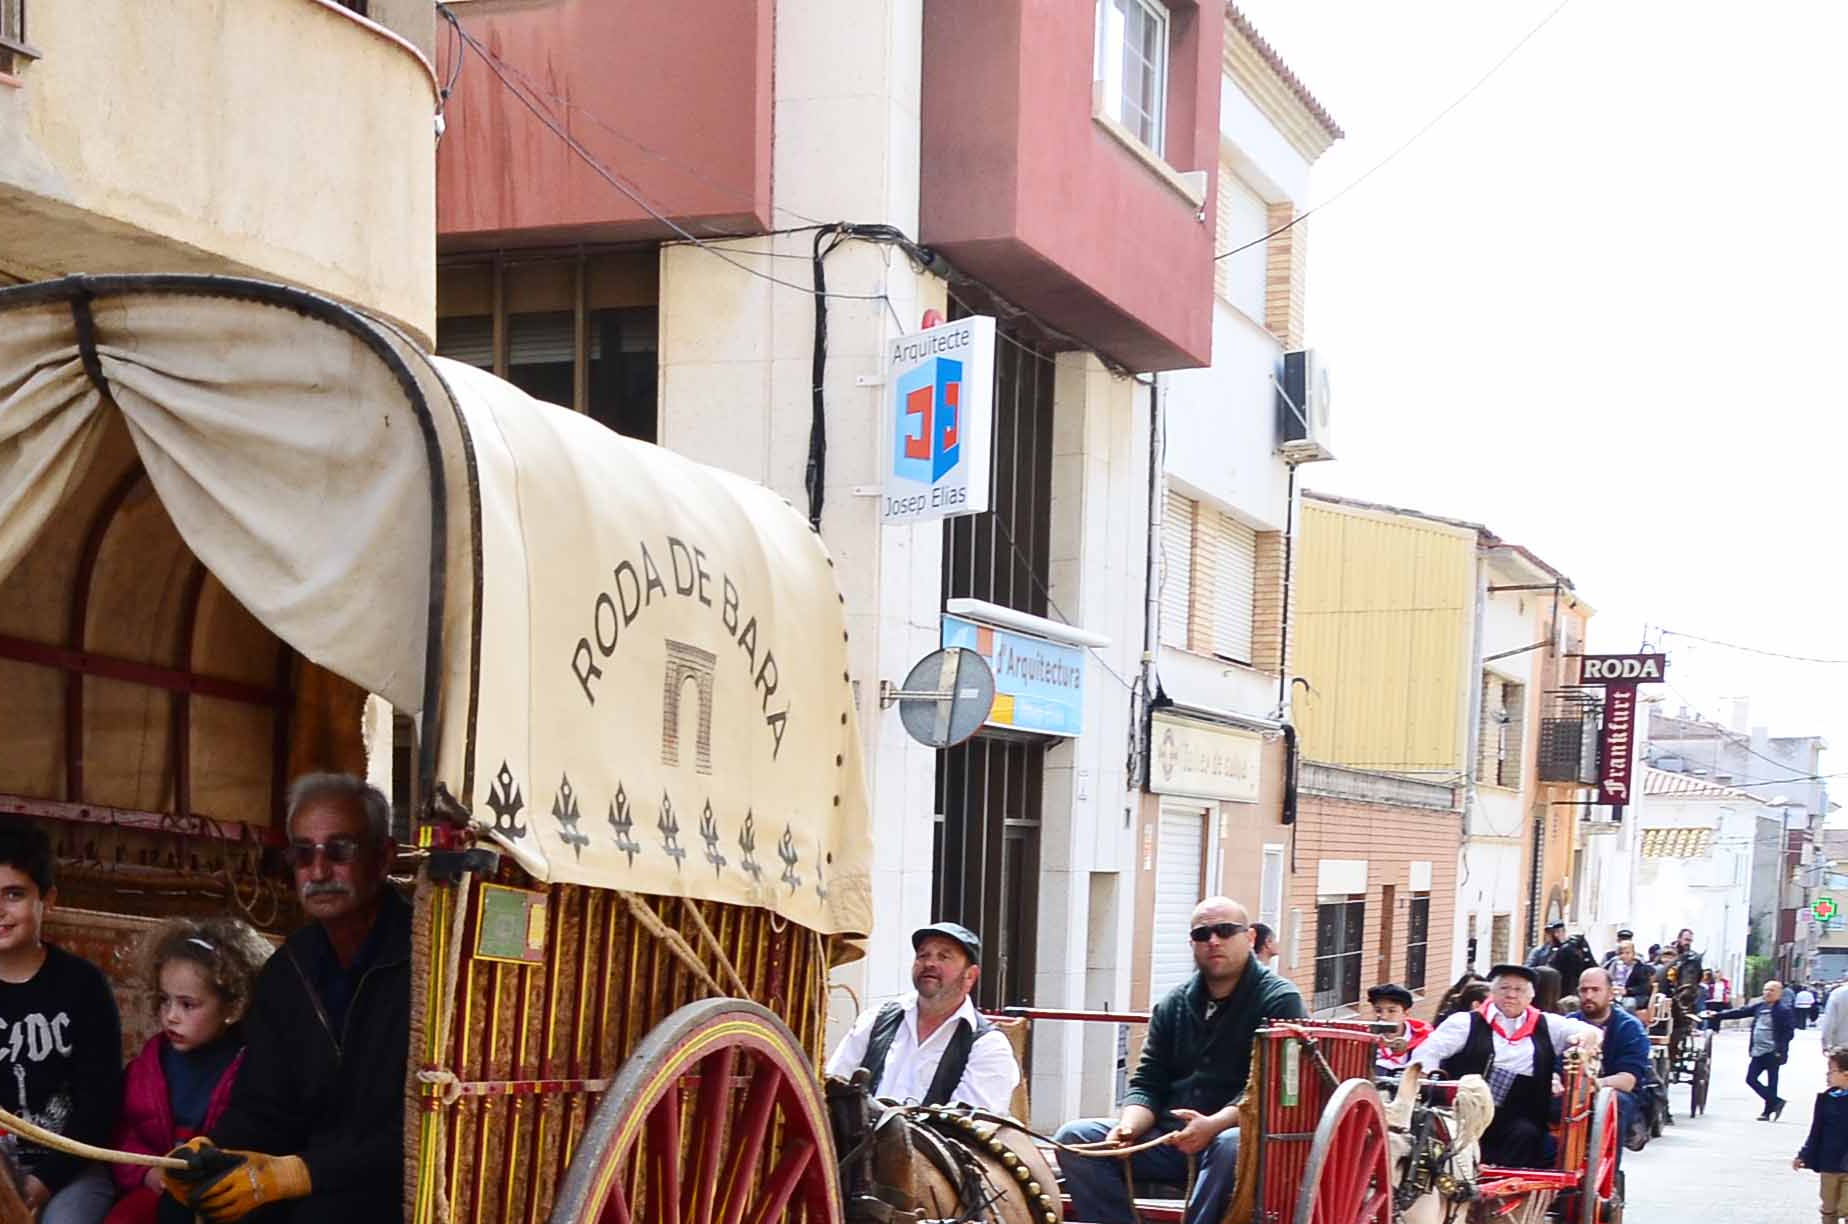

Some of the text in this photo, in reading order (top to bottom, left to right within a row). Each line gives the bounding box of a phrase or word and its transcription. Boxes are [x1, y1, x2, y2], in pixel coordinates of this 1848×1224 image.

[892, 329, 970, 364] Arquitecte
[885, 486, 967, 517] Josep Elias
[571, 541, 666, 707] RODA
[667, 535, 712, 608] DE
[1583, 659, 1659, 678] RODA
[1603, 690, 1631, 799] Frankfurt
